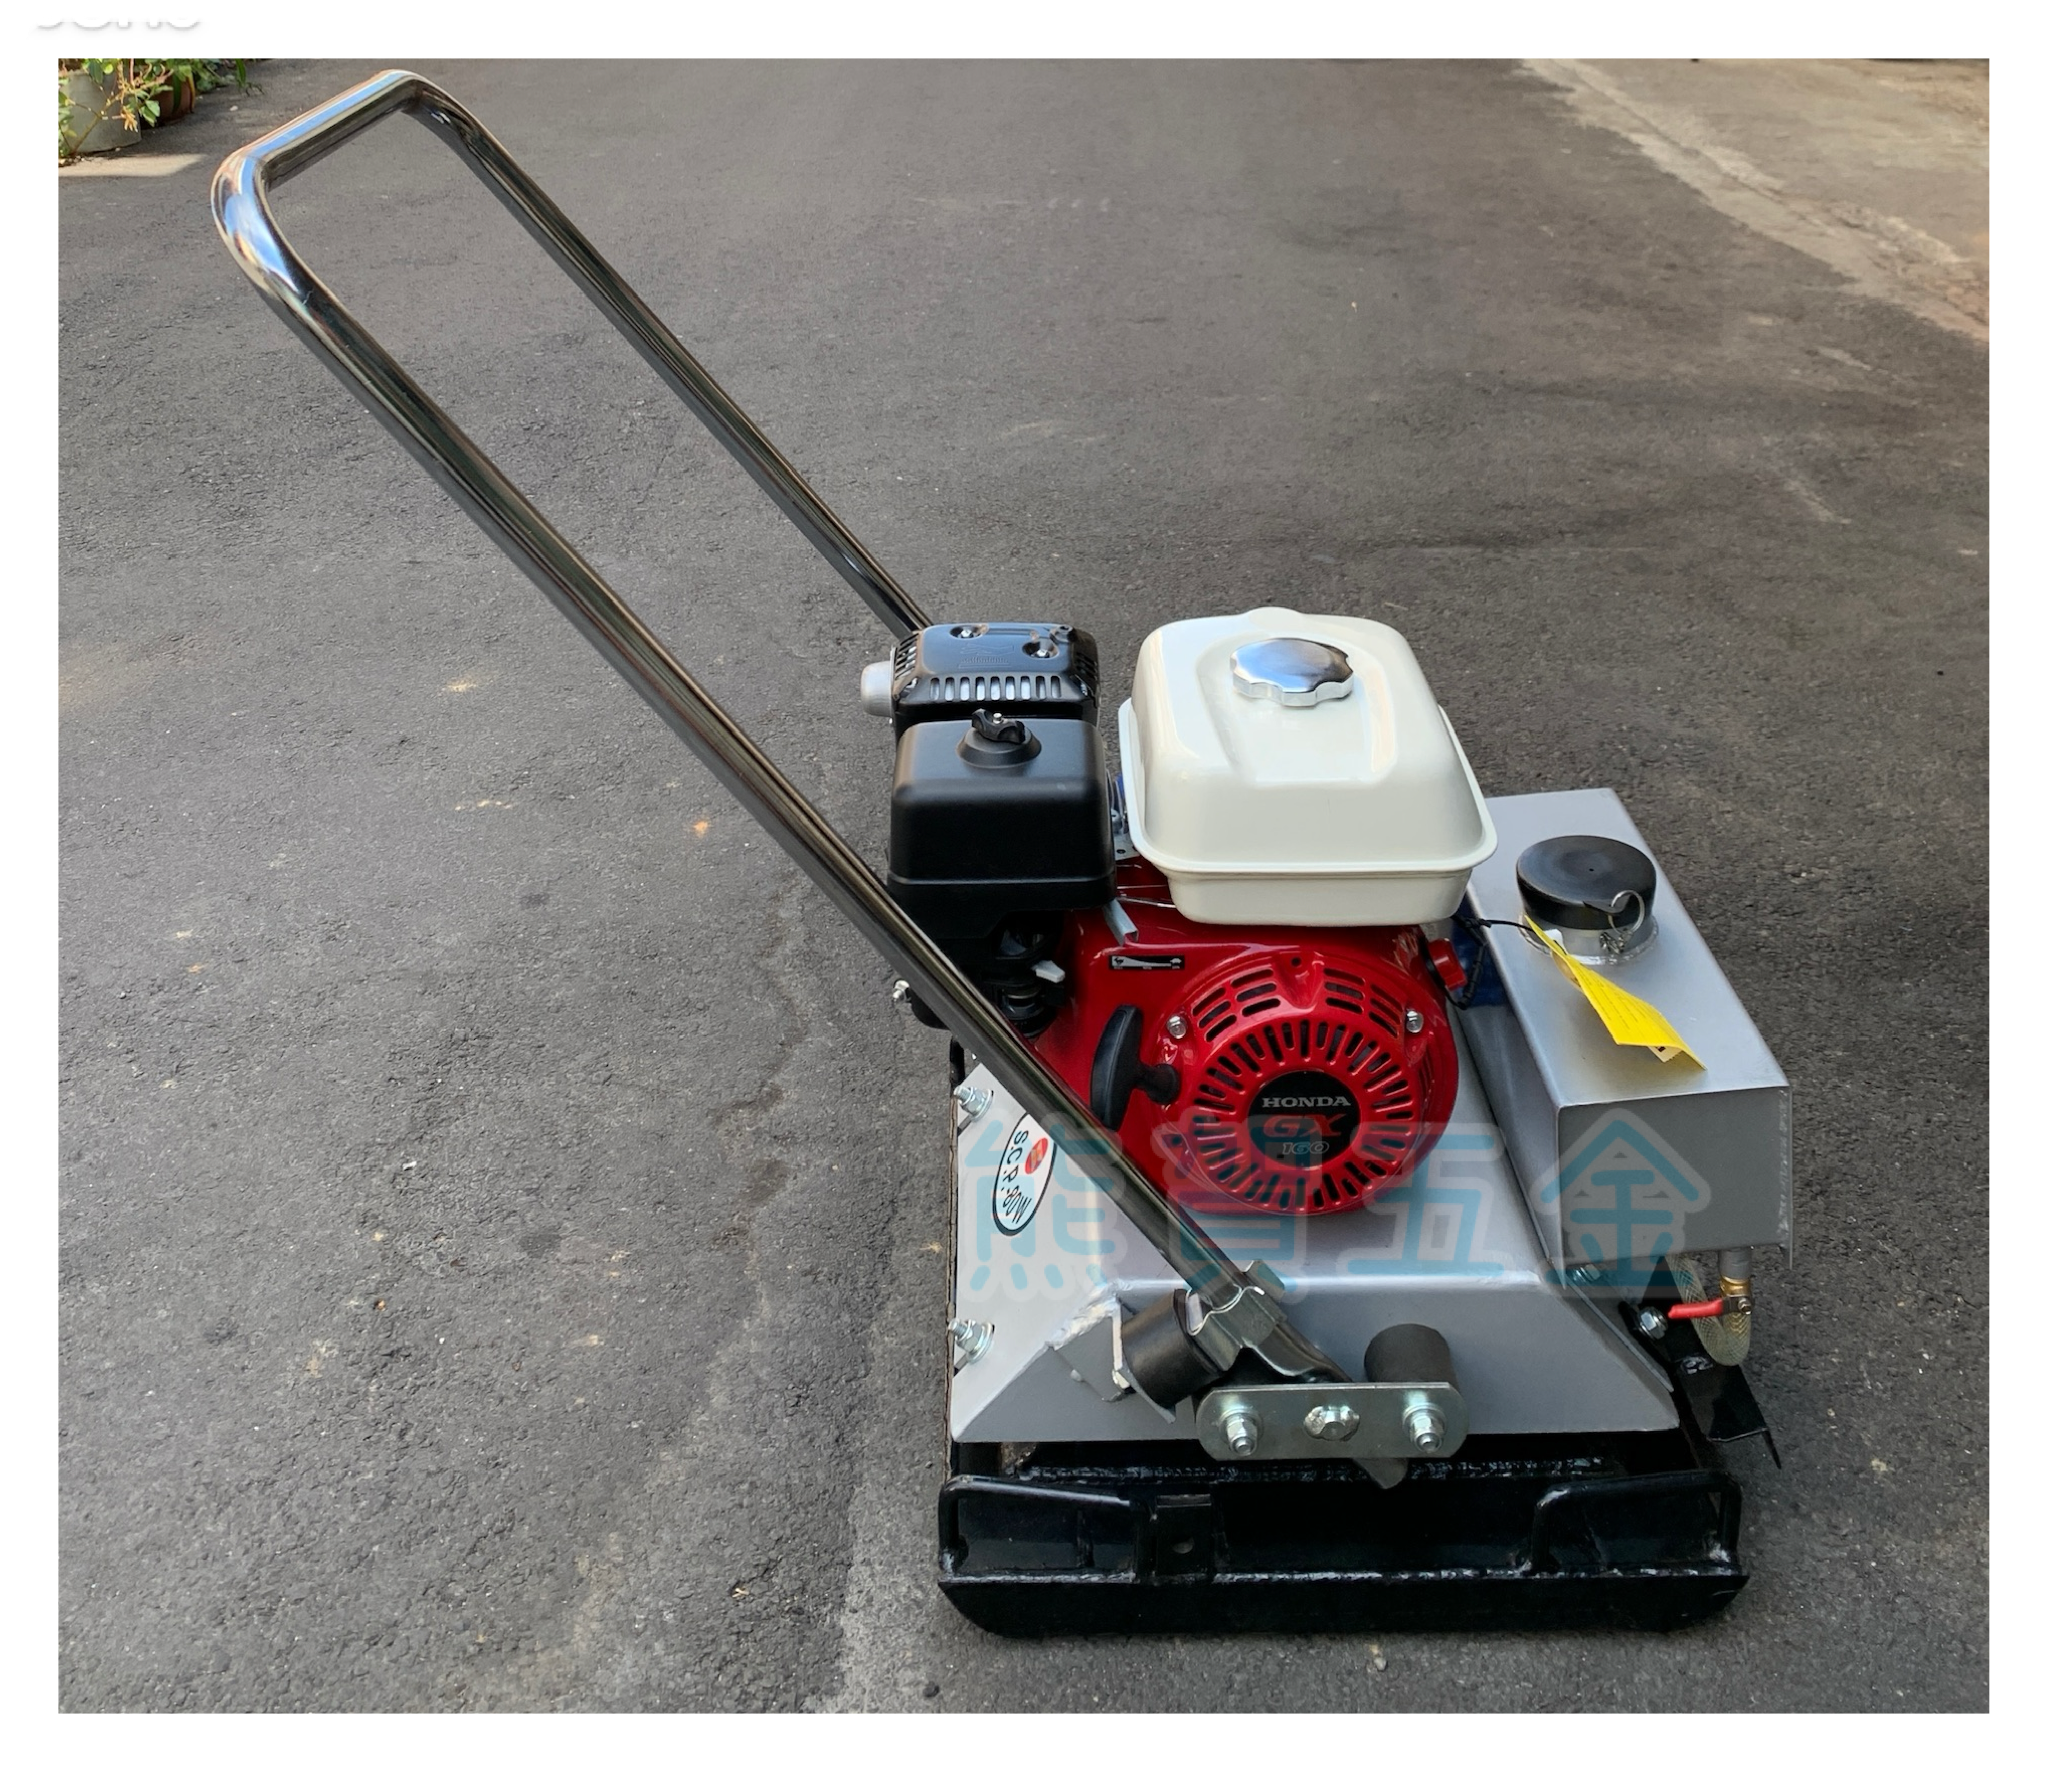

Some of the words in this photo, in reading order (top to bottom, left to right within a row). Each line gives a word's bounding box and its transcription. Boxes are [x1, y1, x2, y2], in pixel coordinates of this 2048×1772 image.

[1262, 1096, 1351, 1108] HONDA
[1263, 1113, 1346, 1138] GX
[1281, 1140, 1330, 1155] 160
